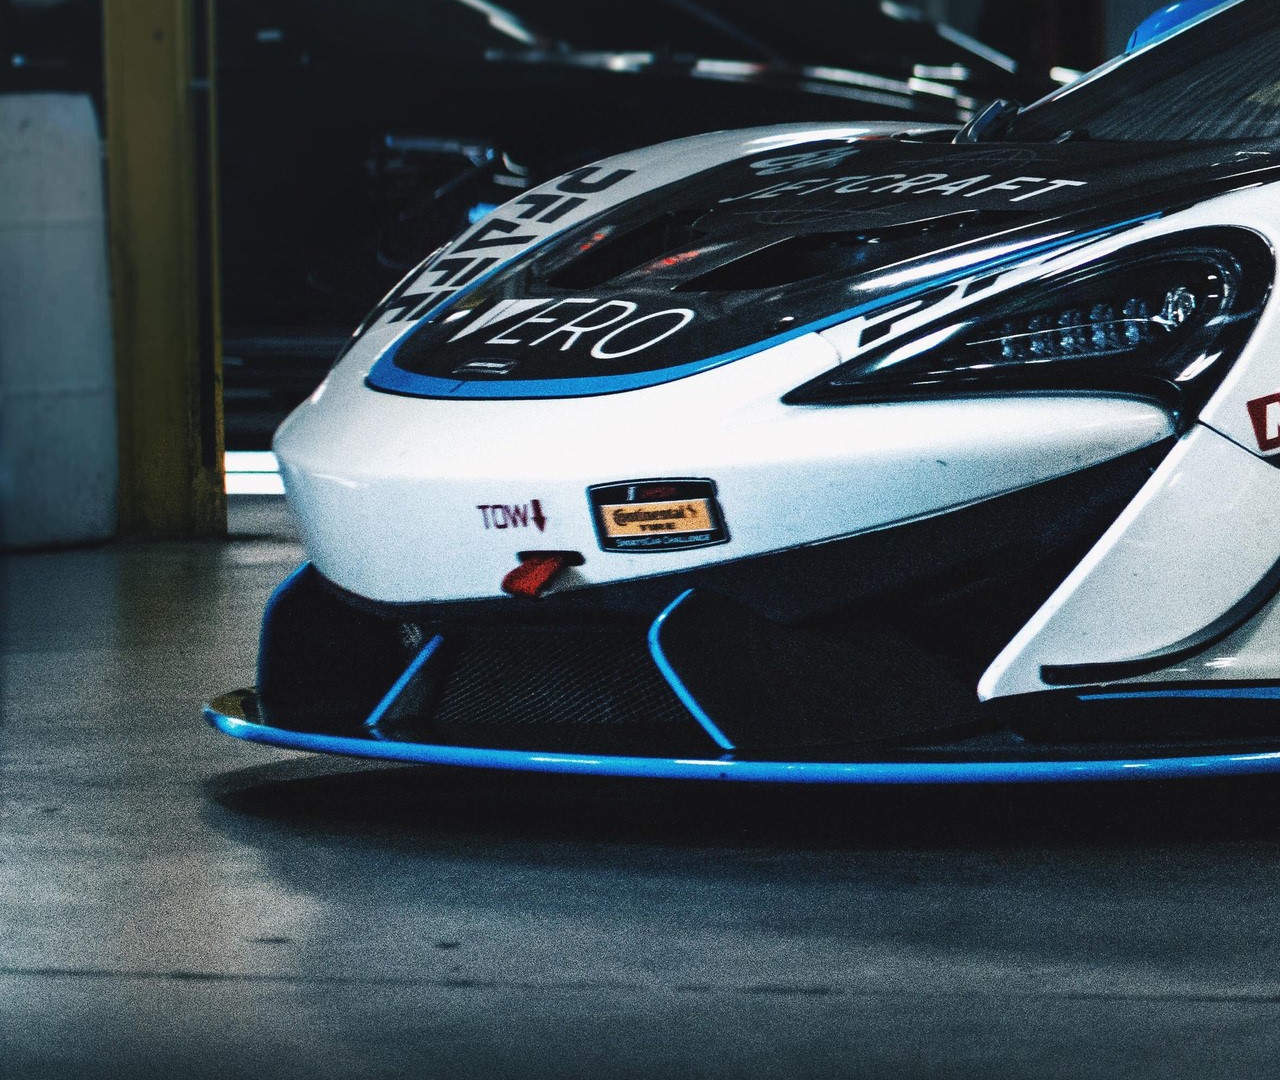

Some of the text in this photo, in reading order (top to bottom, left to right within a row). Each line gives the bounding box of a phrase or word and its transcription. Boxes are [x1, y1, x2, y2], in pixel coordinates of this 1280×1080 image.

[718, 173, 1088, 203] JETCRAFT
[447, 298, 696, 360] VERO
[477, 503, 528, 529] TOW
